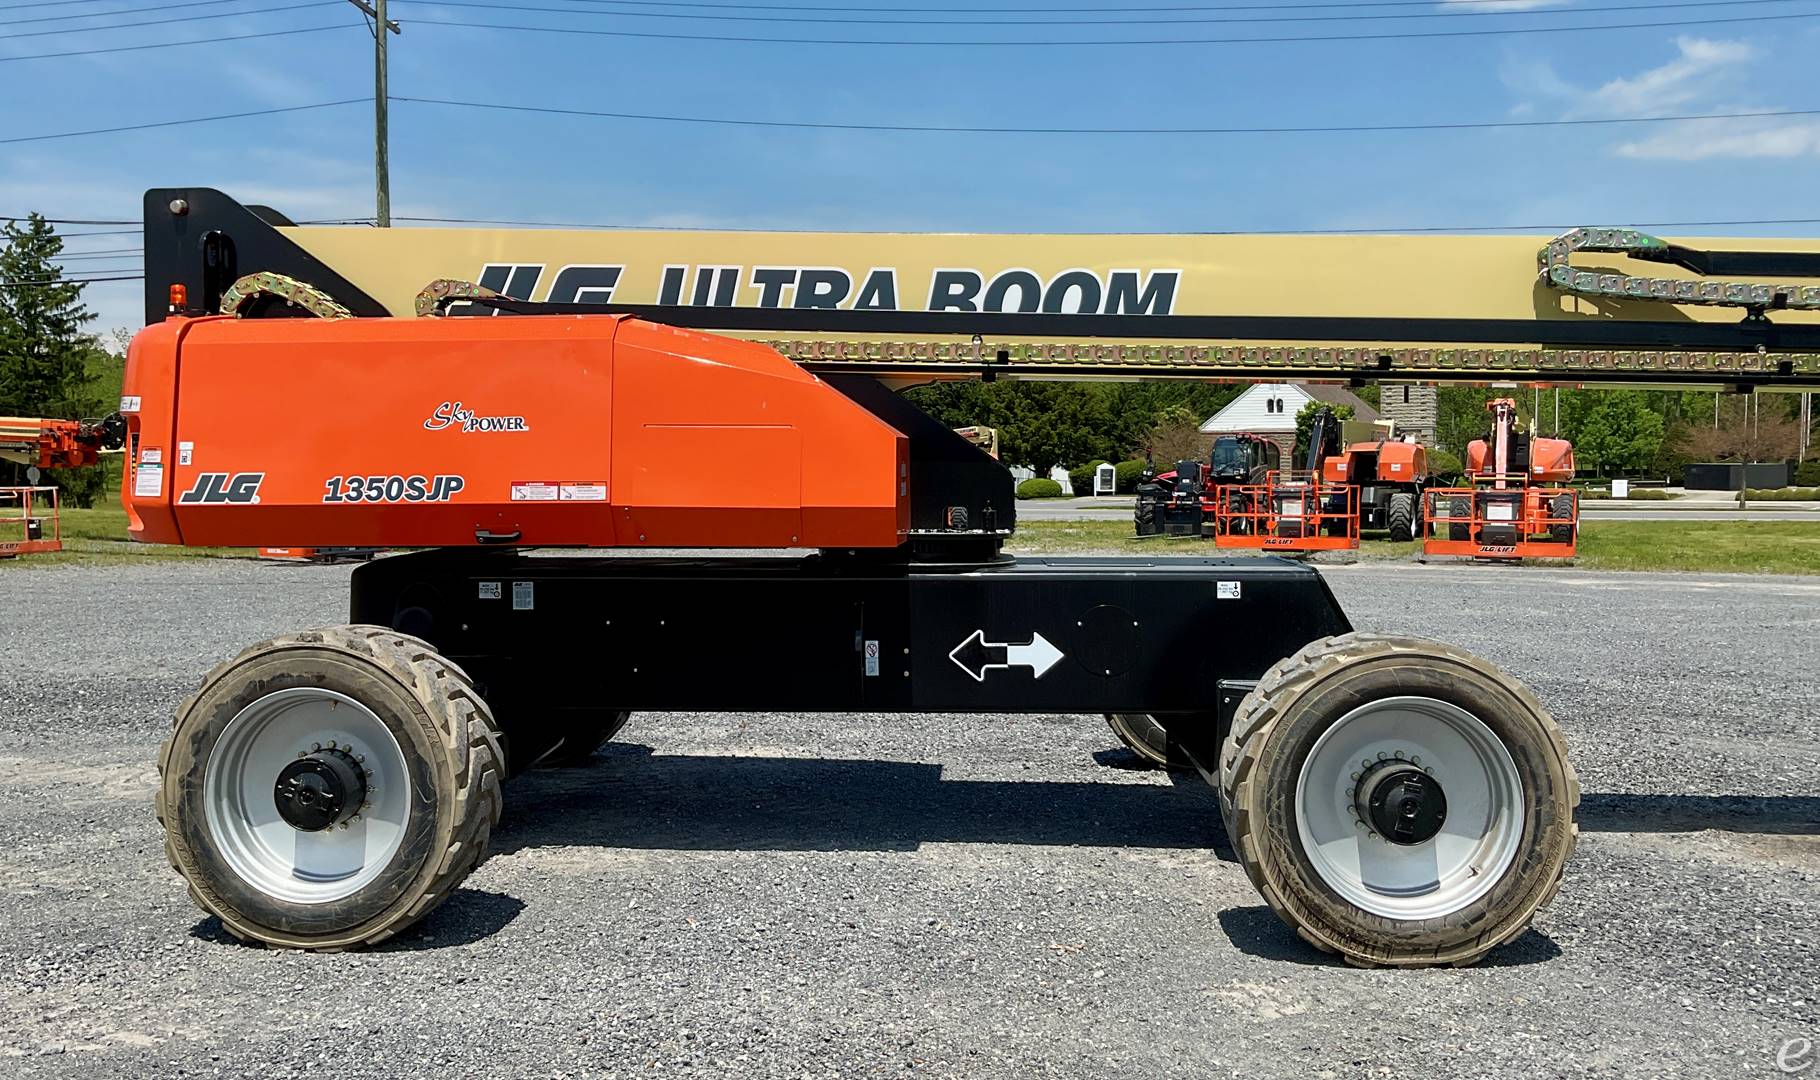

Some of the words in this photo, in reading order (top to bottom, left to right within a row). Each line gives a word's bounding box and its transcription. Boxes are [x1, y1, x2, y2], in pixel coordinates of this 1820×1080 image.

[656, 264, 898, 310] ULTRA
[926, 267, 1183, 316] BOOM
[177, 472, 265, 504] JLG
[322, 475, 465, 503] 1350SJP
